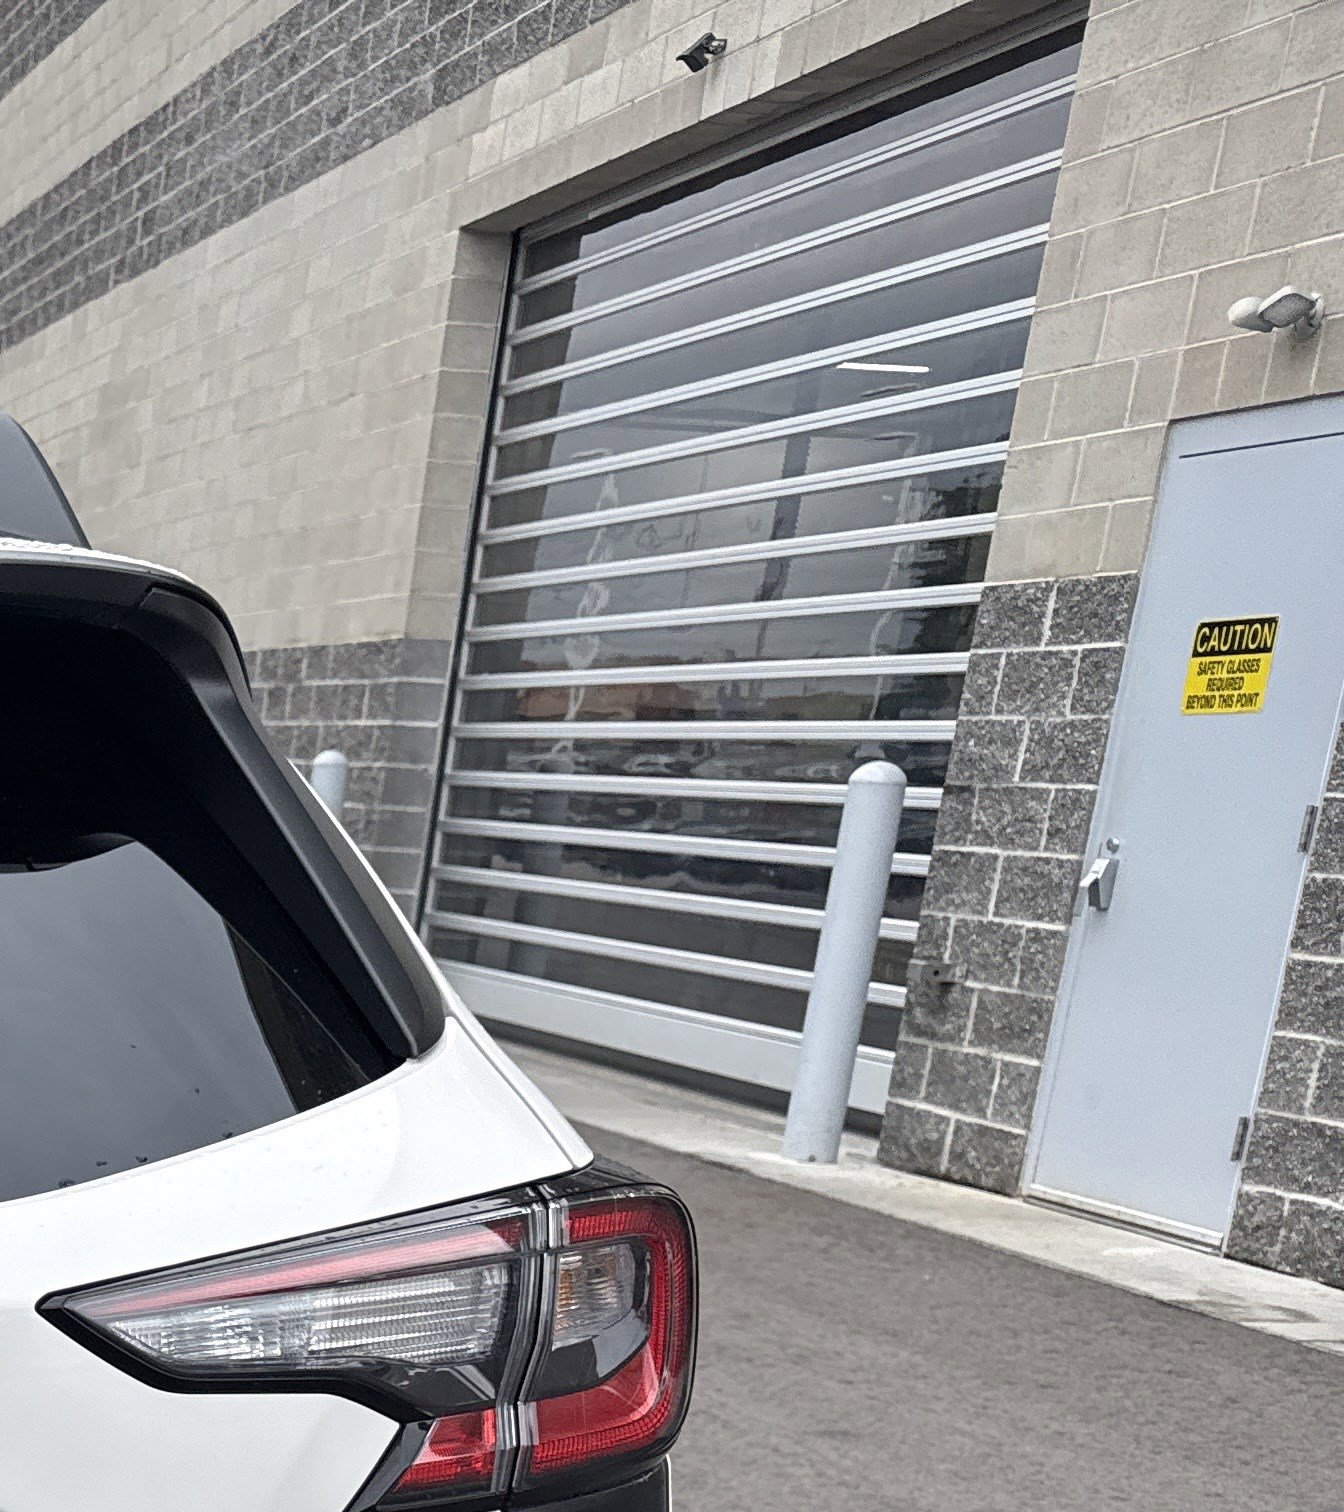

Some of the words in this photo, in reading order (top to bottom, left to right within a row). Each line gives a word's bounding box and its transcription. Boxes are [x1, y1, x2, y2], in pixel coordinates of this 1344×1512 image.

[1196, 621, 1277, 653] CAUTION
[1197, 660, 1226, 676] SAFETY
[1226, 658, 1262, 675] GLASSES
[1205, 676, 1245, 693] REQUIRED
[1185, 694, 1217, 710] BEYOND
[1217, 694, 1236, 709] THIS
[1234, 692, 1260, 708] POINT
